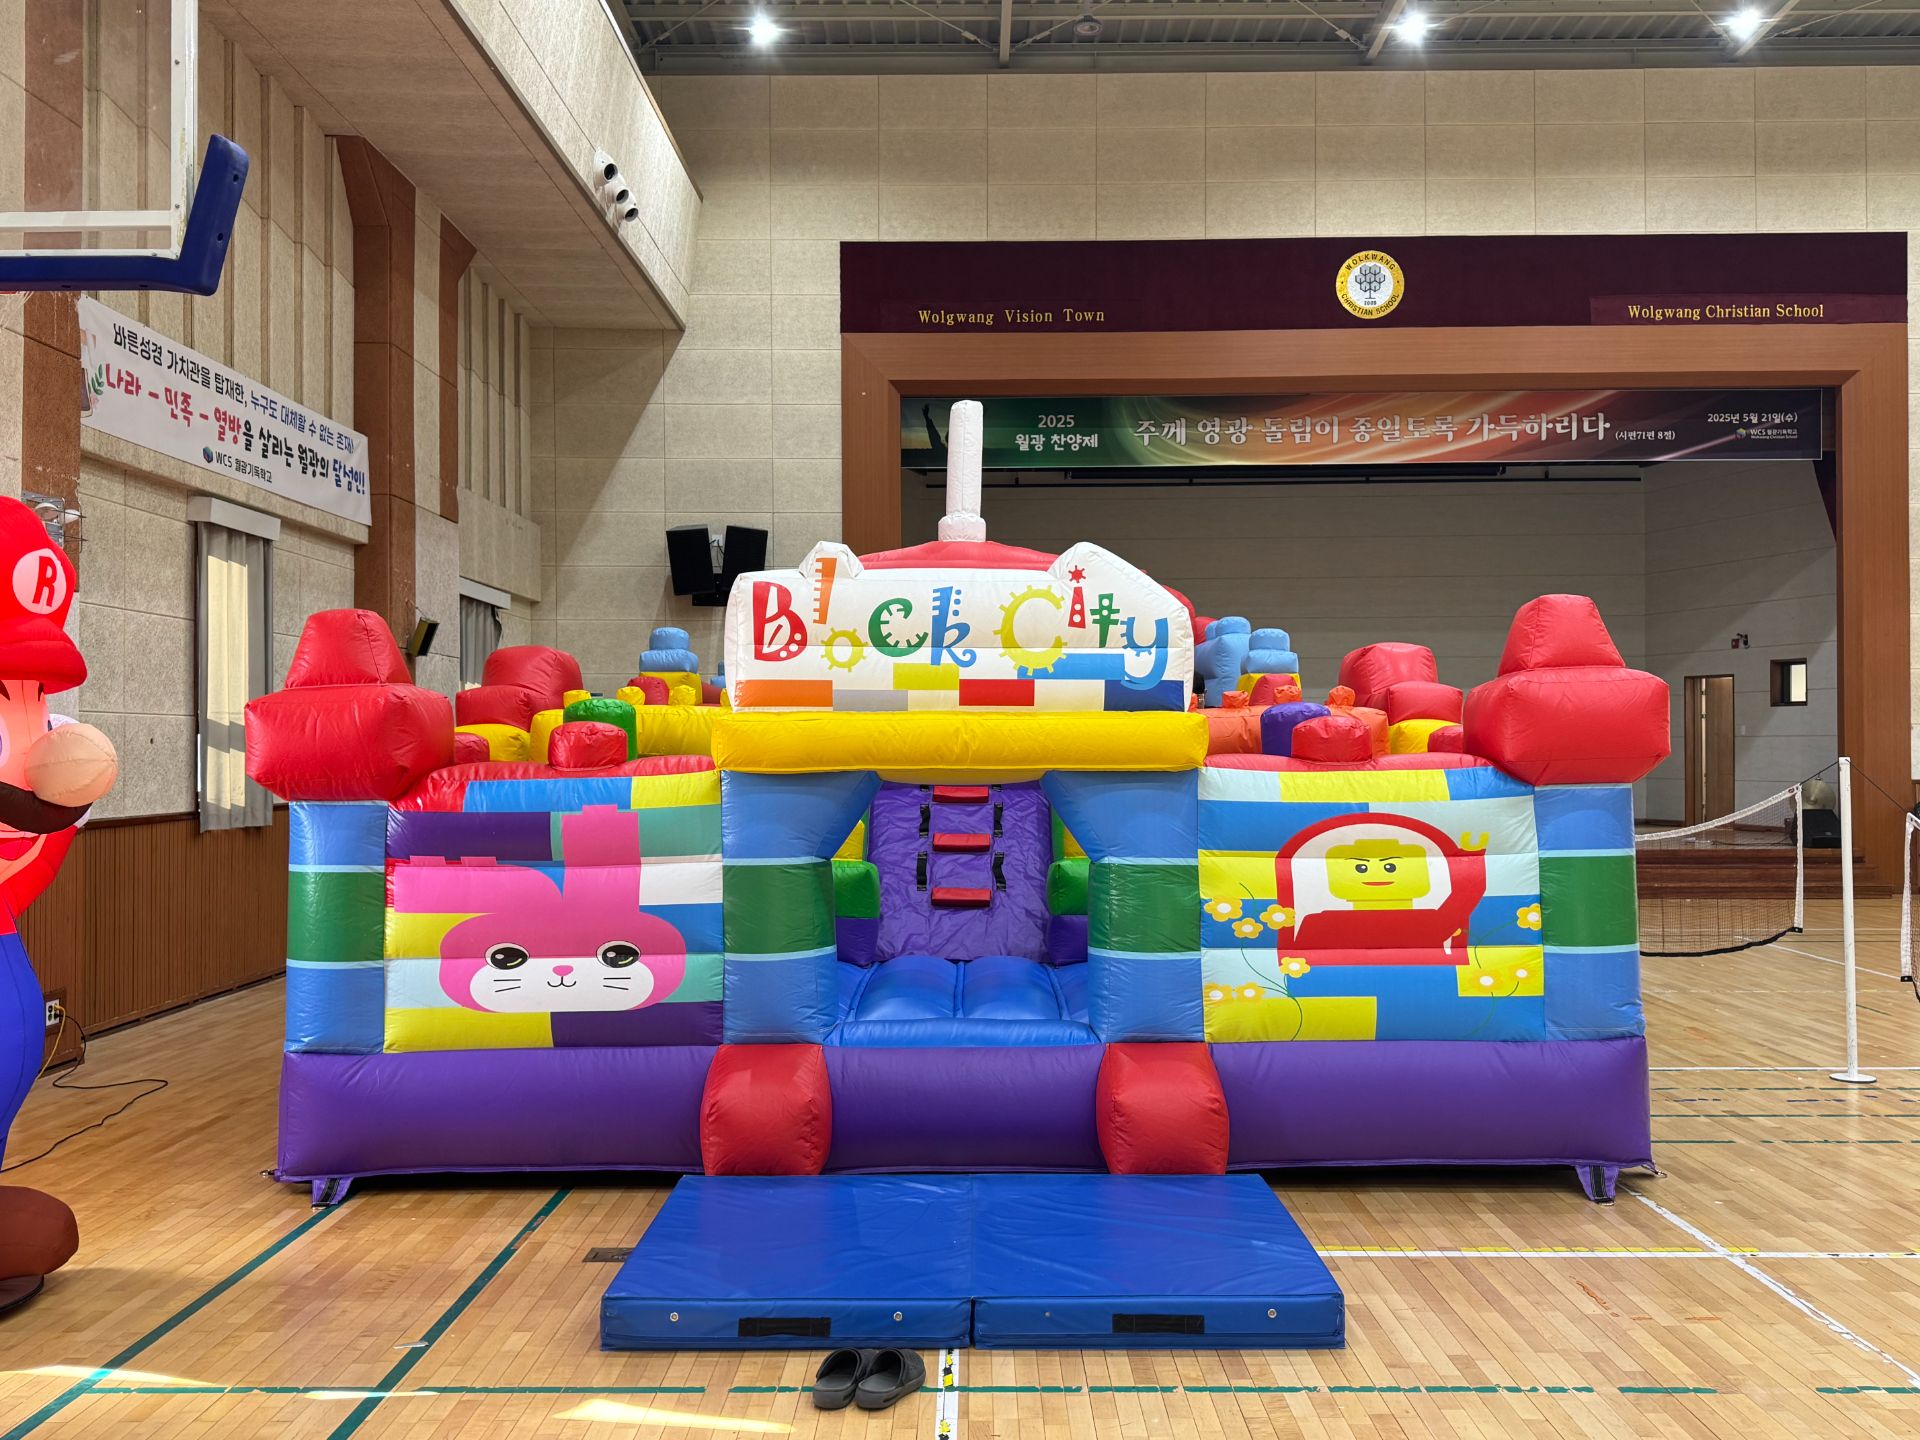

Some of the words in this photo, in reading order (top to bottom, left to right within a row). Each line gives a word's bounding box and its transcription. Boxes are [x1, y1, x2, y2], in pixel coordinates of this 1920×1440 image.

[1345, 253, 1396, 271] WOLKWANG
[1341, 293, 1373, 316] CHRISTIAN
[1375, 293, 1400, 315] SCHOOL
[1628, 305, 1701, 321] Wolgwang
[1705, 304, 1771, 319] Christian
[1775, 303, 1824, 318] School
[918, 310, 995, 326] Wolgwang
[1005, 309, 1053, 323] Vision
[1063, 308, 1105, 322] Town
[113, 322, 163, 367] 바른성경
[167, 349, 211, 389] 가치관을
[250, 389, 278, 420] 누구도
[308, 419, 317, 438] 수
[105, 363, 142, 397] 나라
[164, 386, 194, 428] 민족
[213, 406, 254, 452] 열방을
[258, 425, 294, 468] 살리는
[297, 443, 330, 478] 월광의
[1037, 414, 1075, 428] 2025
[1707, 412, 1740, 424] 2025년
[1743, 412, 1758, 424] 5월
[1761, 411, 1798, 424] 21일(수)
[1133, 417, 1187, 447] 주께
[1197, 416, 1254, 445] 영광
[1261, 415, 1340, 445] 돌림이
[1348, 414, 1459, 443] 종일토록
[1465, 411, 1611, 442] 가득하리다
[1750, 428, 1766, 436] WCS
[1014, 433, 1046, 452] 월광
[1050, 433, 1099, 452] 찬양제
[215, 451, 233, 468] WCS
[32, 555, 57, 608] R
[753, 557, 977, 673] Block
[992, 565, 1168, 691] City
